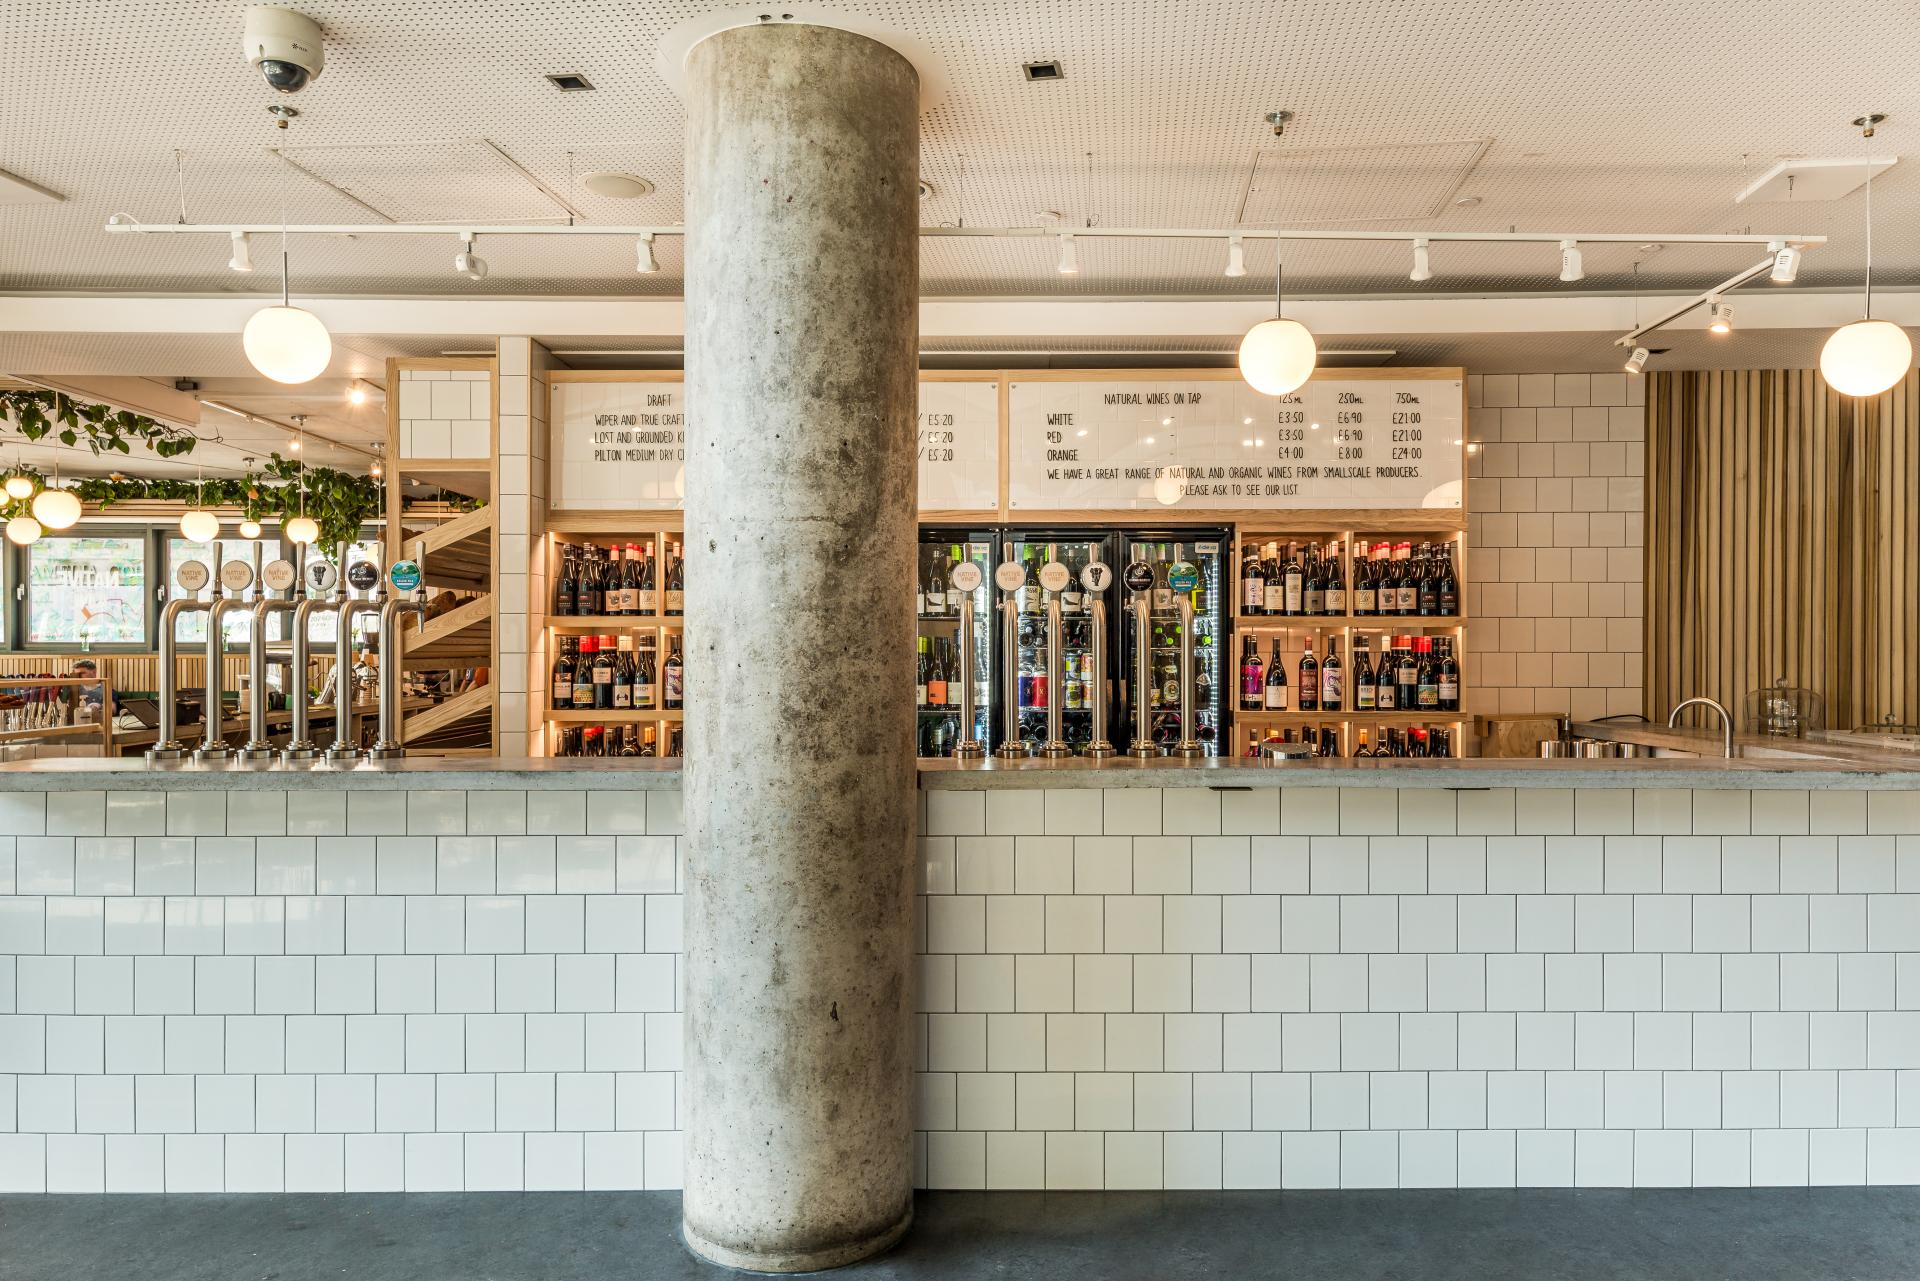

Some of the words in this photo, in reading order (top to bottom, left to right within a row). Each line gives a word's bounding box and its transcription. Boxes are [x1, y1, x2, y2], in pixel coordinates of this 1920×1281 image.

[647, 393, 672, 407] DRAFT
[1104, 392, 1143, 406] NATURAL
[1147, 392, 1171, 405] WINES
[1174, 392, 1185, 405] ON
[1188, 391, 1202, 405] TAP
[594, 414, 619, 426] WIPER
[621, 414, 637, 426] AND
[641, 414, 659, 426] TRUE
[1046, 412, 1075, 426] WHITE
[594, 431, 616, 444] LOST
[617, 431, 632, 444] AND
[635, 431, 674, 444] GROUNDED
[1046, 430, 1063, 444] RED
[594, 449, 622, 462] PILTON
[625, 449, 655, 462] MEDIUM
[659, 449, 674, 461] DRY
[1046, 448, 1079, 462] ORANGE
[1046, 468, 1061, 480] WE
[1064, 468, 1084, 480] HAVE
[1086, 468, 1092, 480] A
[1095, 468, 1120, 480] GREAT
[1125, 468, 1152, 480] RANGE
[1154, 467, 1165, 480] OF
[1169, 467, 1206, 480] NATURAL
[1209, 467, 1225, 480] AND
[1228, 466, 1263, 479] ORGANIC
[1267, 466, 1293, 479] WINES
[1296, 466, 1319, 479] FROM
[1323, 466, 1372, 479] SMALLSCALE
[1376, 466, 1423, 479] PRODUCERS.
[1179, 484, 1210, 496] PLEASE
[1213, 484, 1228, 496] ASK
[1232, 484, 1242, 496] TO
[1246, 484, 1261, 496] SEE
[1265, 484, 1281, 496] OUR
[1283, 483, 1299, 496] LIST
